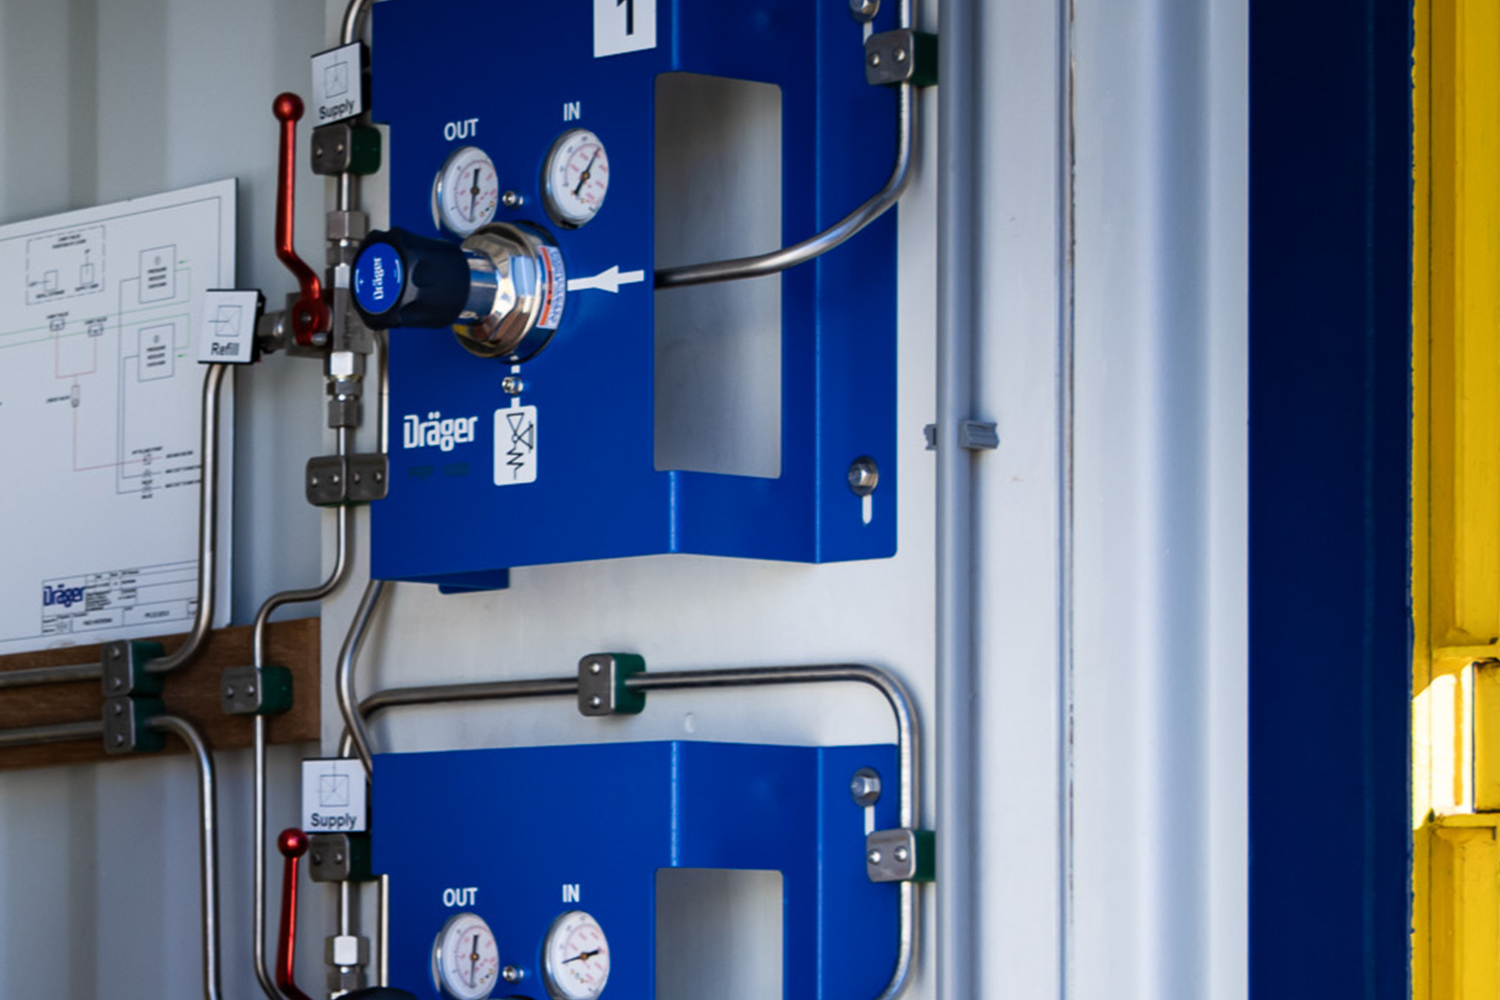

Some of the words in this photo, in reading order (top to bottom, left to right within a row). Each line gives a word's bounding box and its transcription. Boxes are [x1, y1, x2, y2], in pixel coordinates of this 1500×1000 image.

[617, 0, 635, 35] 1
[318, 98, 355, 121] Supply
[562, 102, 581, 121] IN
[443, 119, 479, 141] OUT
[373, 257, 385, 300] Dräger
[210, 341, 240, 358] Refill
[403, 410, 479, 452] Dräger
[43, 584, 86, 607] Dräger
[310, 812, 358, 831] Supply
[443, 887, 478, 908] OUT
[562, 884, 579, 904] IN
